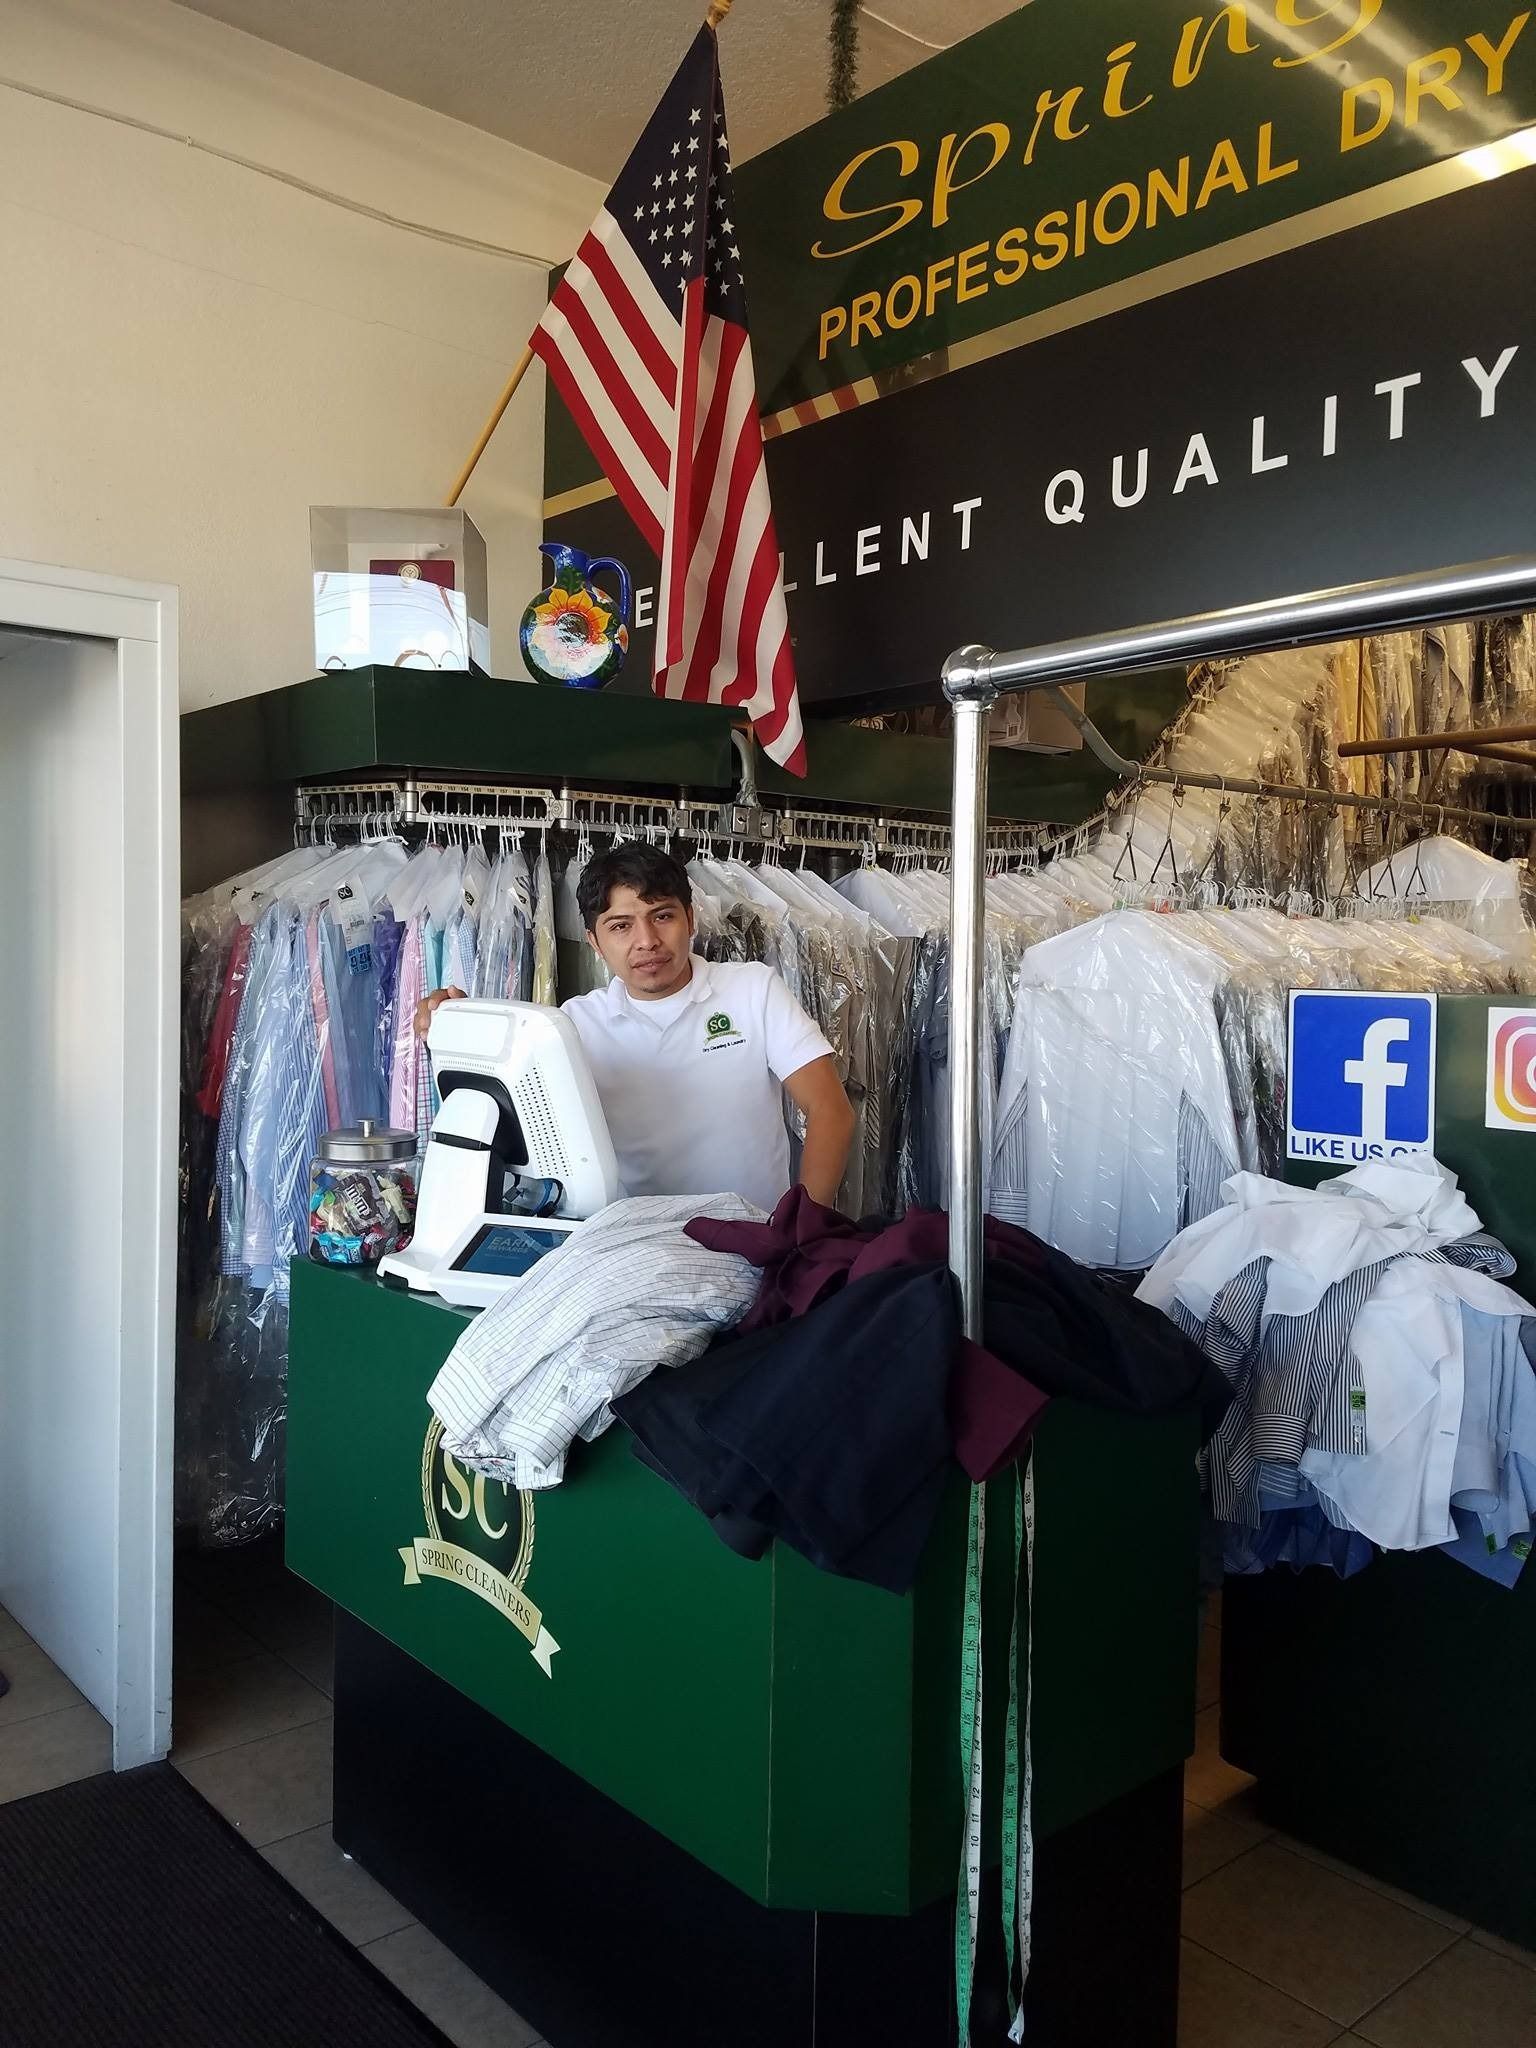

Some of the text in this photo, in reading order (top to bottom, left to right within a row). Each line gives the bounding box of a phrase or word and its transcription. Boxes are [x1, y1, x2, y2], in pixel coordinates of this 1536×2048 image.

[811, 0, 1382, 259] Spring
[818, 13, 1532, 361] PROFESSIONAL DRY
[635, 345, 1520, 629] ELLENT QUALITY
[339, 886, 352, 899] SC
[710, 1017, 727, 1031] SC
[1291, 1136, 1345, 1159] LIKE
[1352, 1142, 1384, 1162] US
[441, 1450, 508, 1539] SC
[421, 1547, 531, 1627] SPRING CLEANERS
[967, 1615, 976, 1627] 19
[966, 1665, 974, 1677] 17
[973, 1763, 981, 1775] 13
[972, 1787, 980, 1799] 12
[971, 1813, 979, 1823] 11
[970, 1835, 979, 1847] 10
